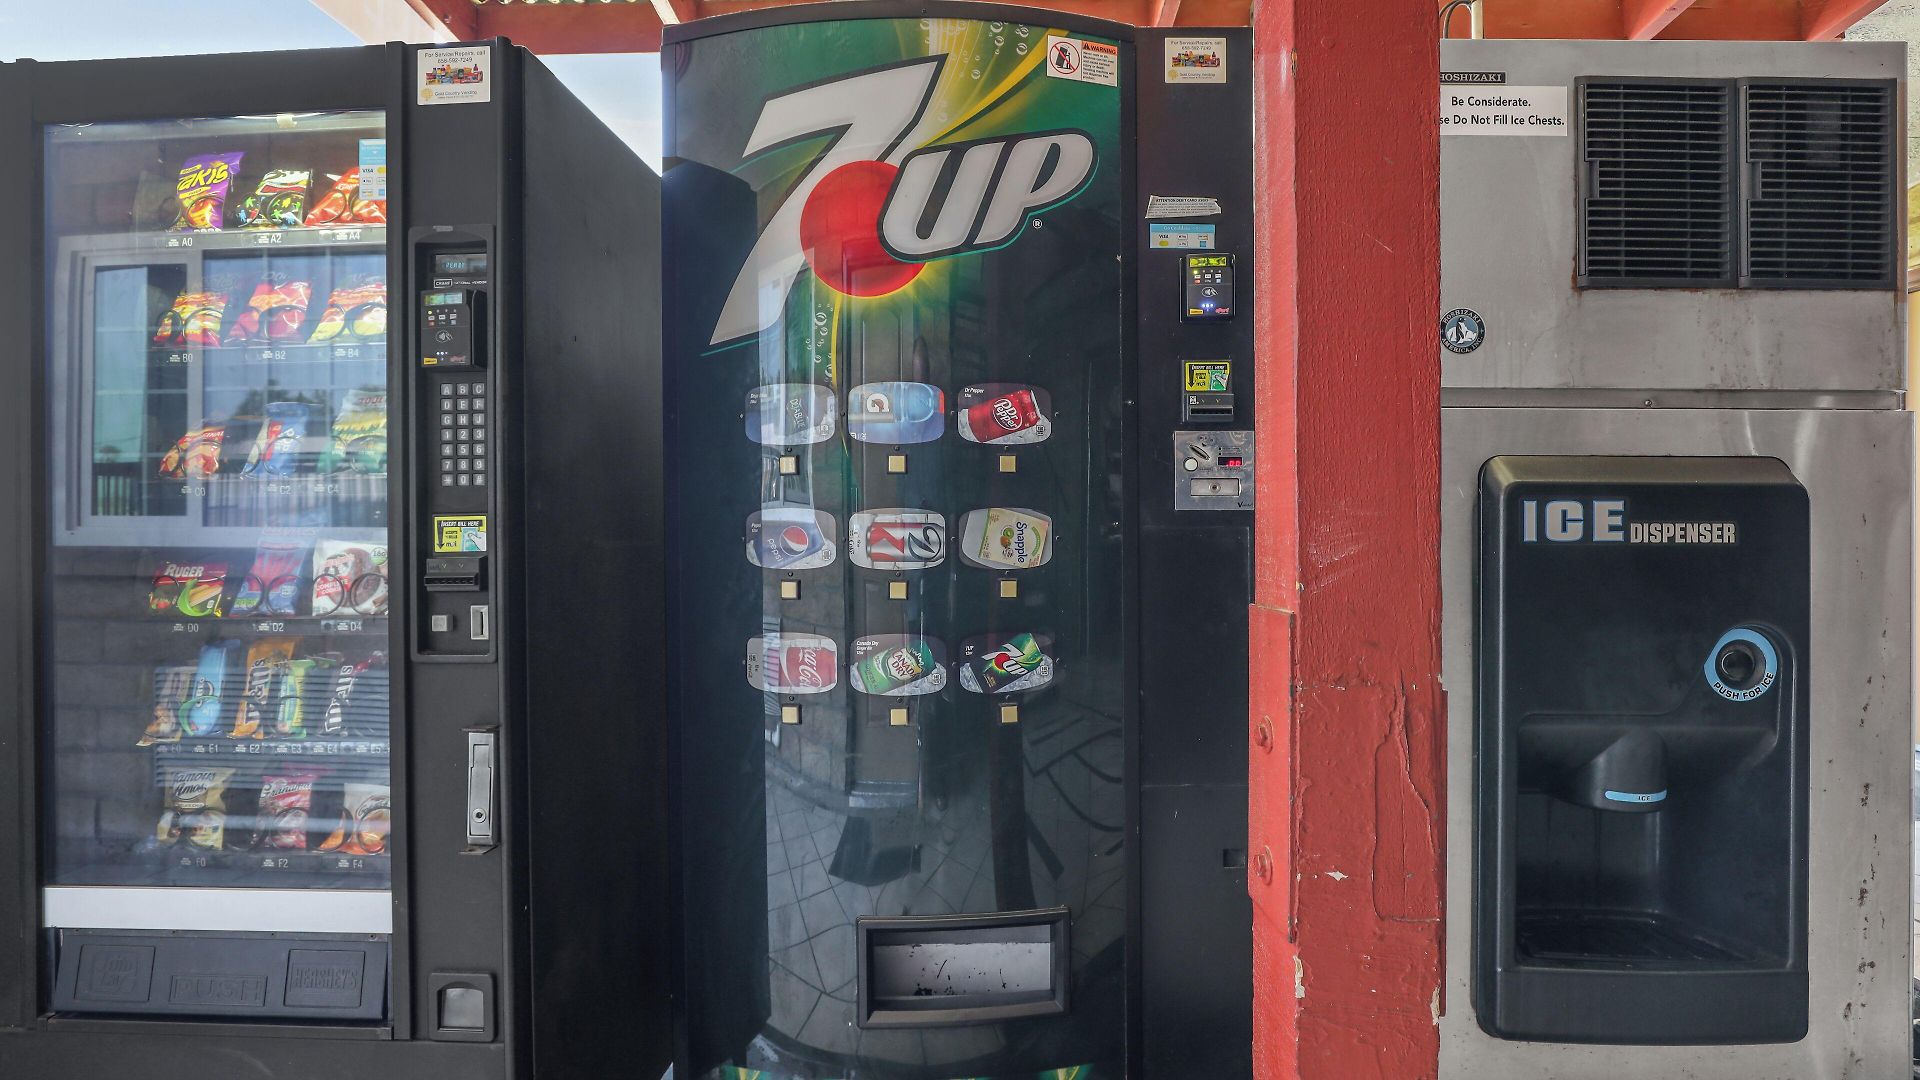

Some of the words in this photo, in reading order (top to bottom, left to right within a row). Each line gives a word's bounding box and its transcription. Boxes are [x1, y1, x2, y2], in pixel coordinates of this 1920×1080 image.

[1091, 46, 1116, 54] WARNING
[1451, 97, 1464, 106] Be
[1468, 96, 1531, 106] Considerate.
[1454, 115, 1467, 124] Do
[1471, 115, 1490, 125] Not
[1494, 115, 1507, 124] Fill
[1511, 116, 1525, 125] Ice
[1529, 115, 1564, 125] Chests.
[270, 233, 282, 243] A2
[349, 232, 360, 240] A4
[1443, 310, 1481, 323] HOSHIZAKI
[1524, 500, 1624, 542] ICE
[1630, 523, 1736, 543] DISPENSER
[1015, 521, 1028, 563] Snapple
[767, 538, 782, 561] pepsi
[892, 648, 918, 678] CANADA
[892, 661, 907, 676] DRY
[1714, 682, 1740, 699] PUSH
[1743, 687, 1762, 699] FOR
[1761, 672, 1774, 688] ICE
[250, 745, 260, 753] E2
[174, 978, 262, 1000] PUSH
